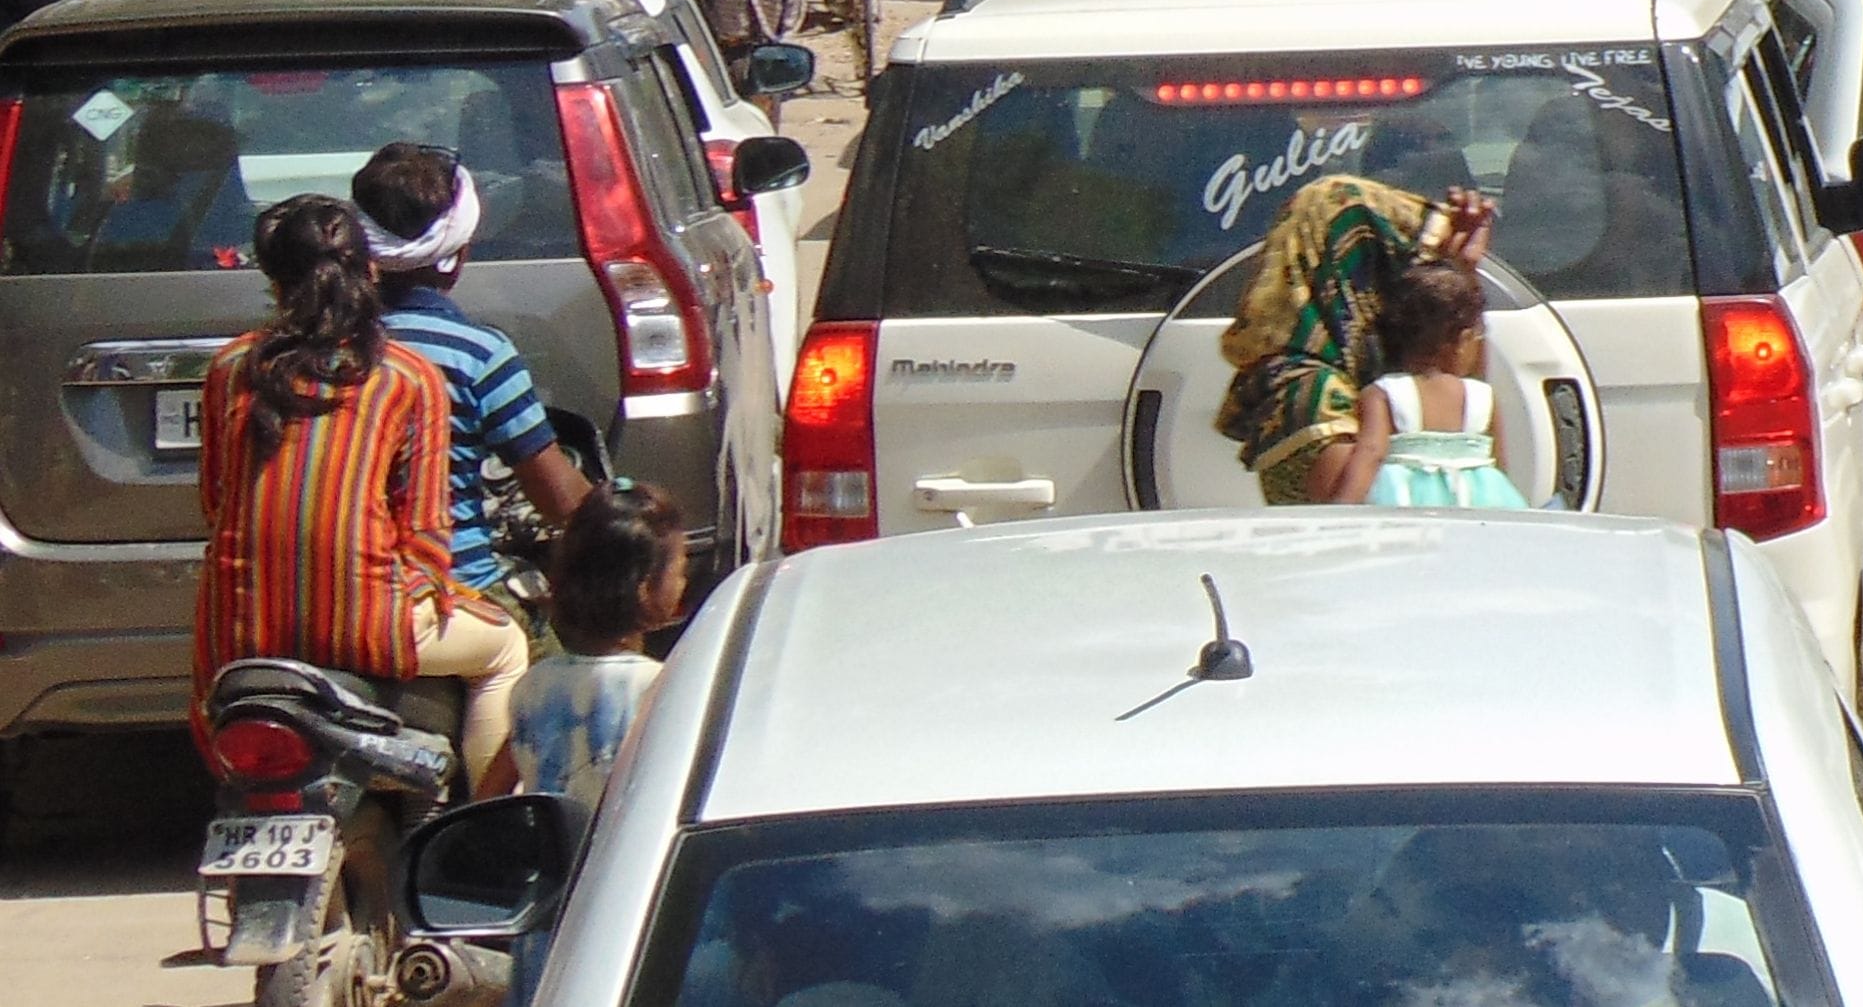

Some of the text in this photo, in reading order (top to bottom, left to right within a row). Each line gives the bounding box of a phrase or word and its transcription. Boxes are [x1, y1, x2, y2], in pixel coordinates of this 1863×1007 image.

[1562, 50, 1601, 68] LIVE
[1604, 49, 1653, 65] FREE
[1203, 121, 1368, 231] Gulia
[225, 824, 315, 846] HR 10 J
[214, 848, 314, 870] 5603
